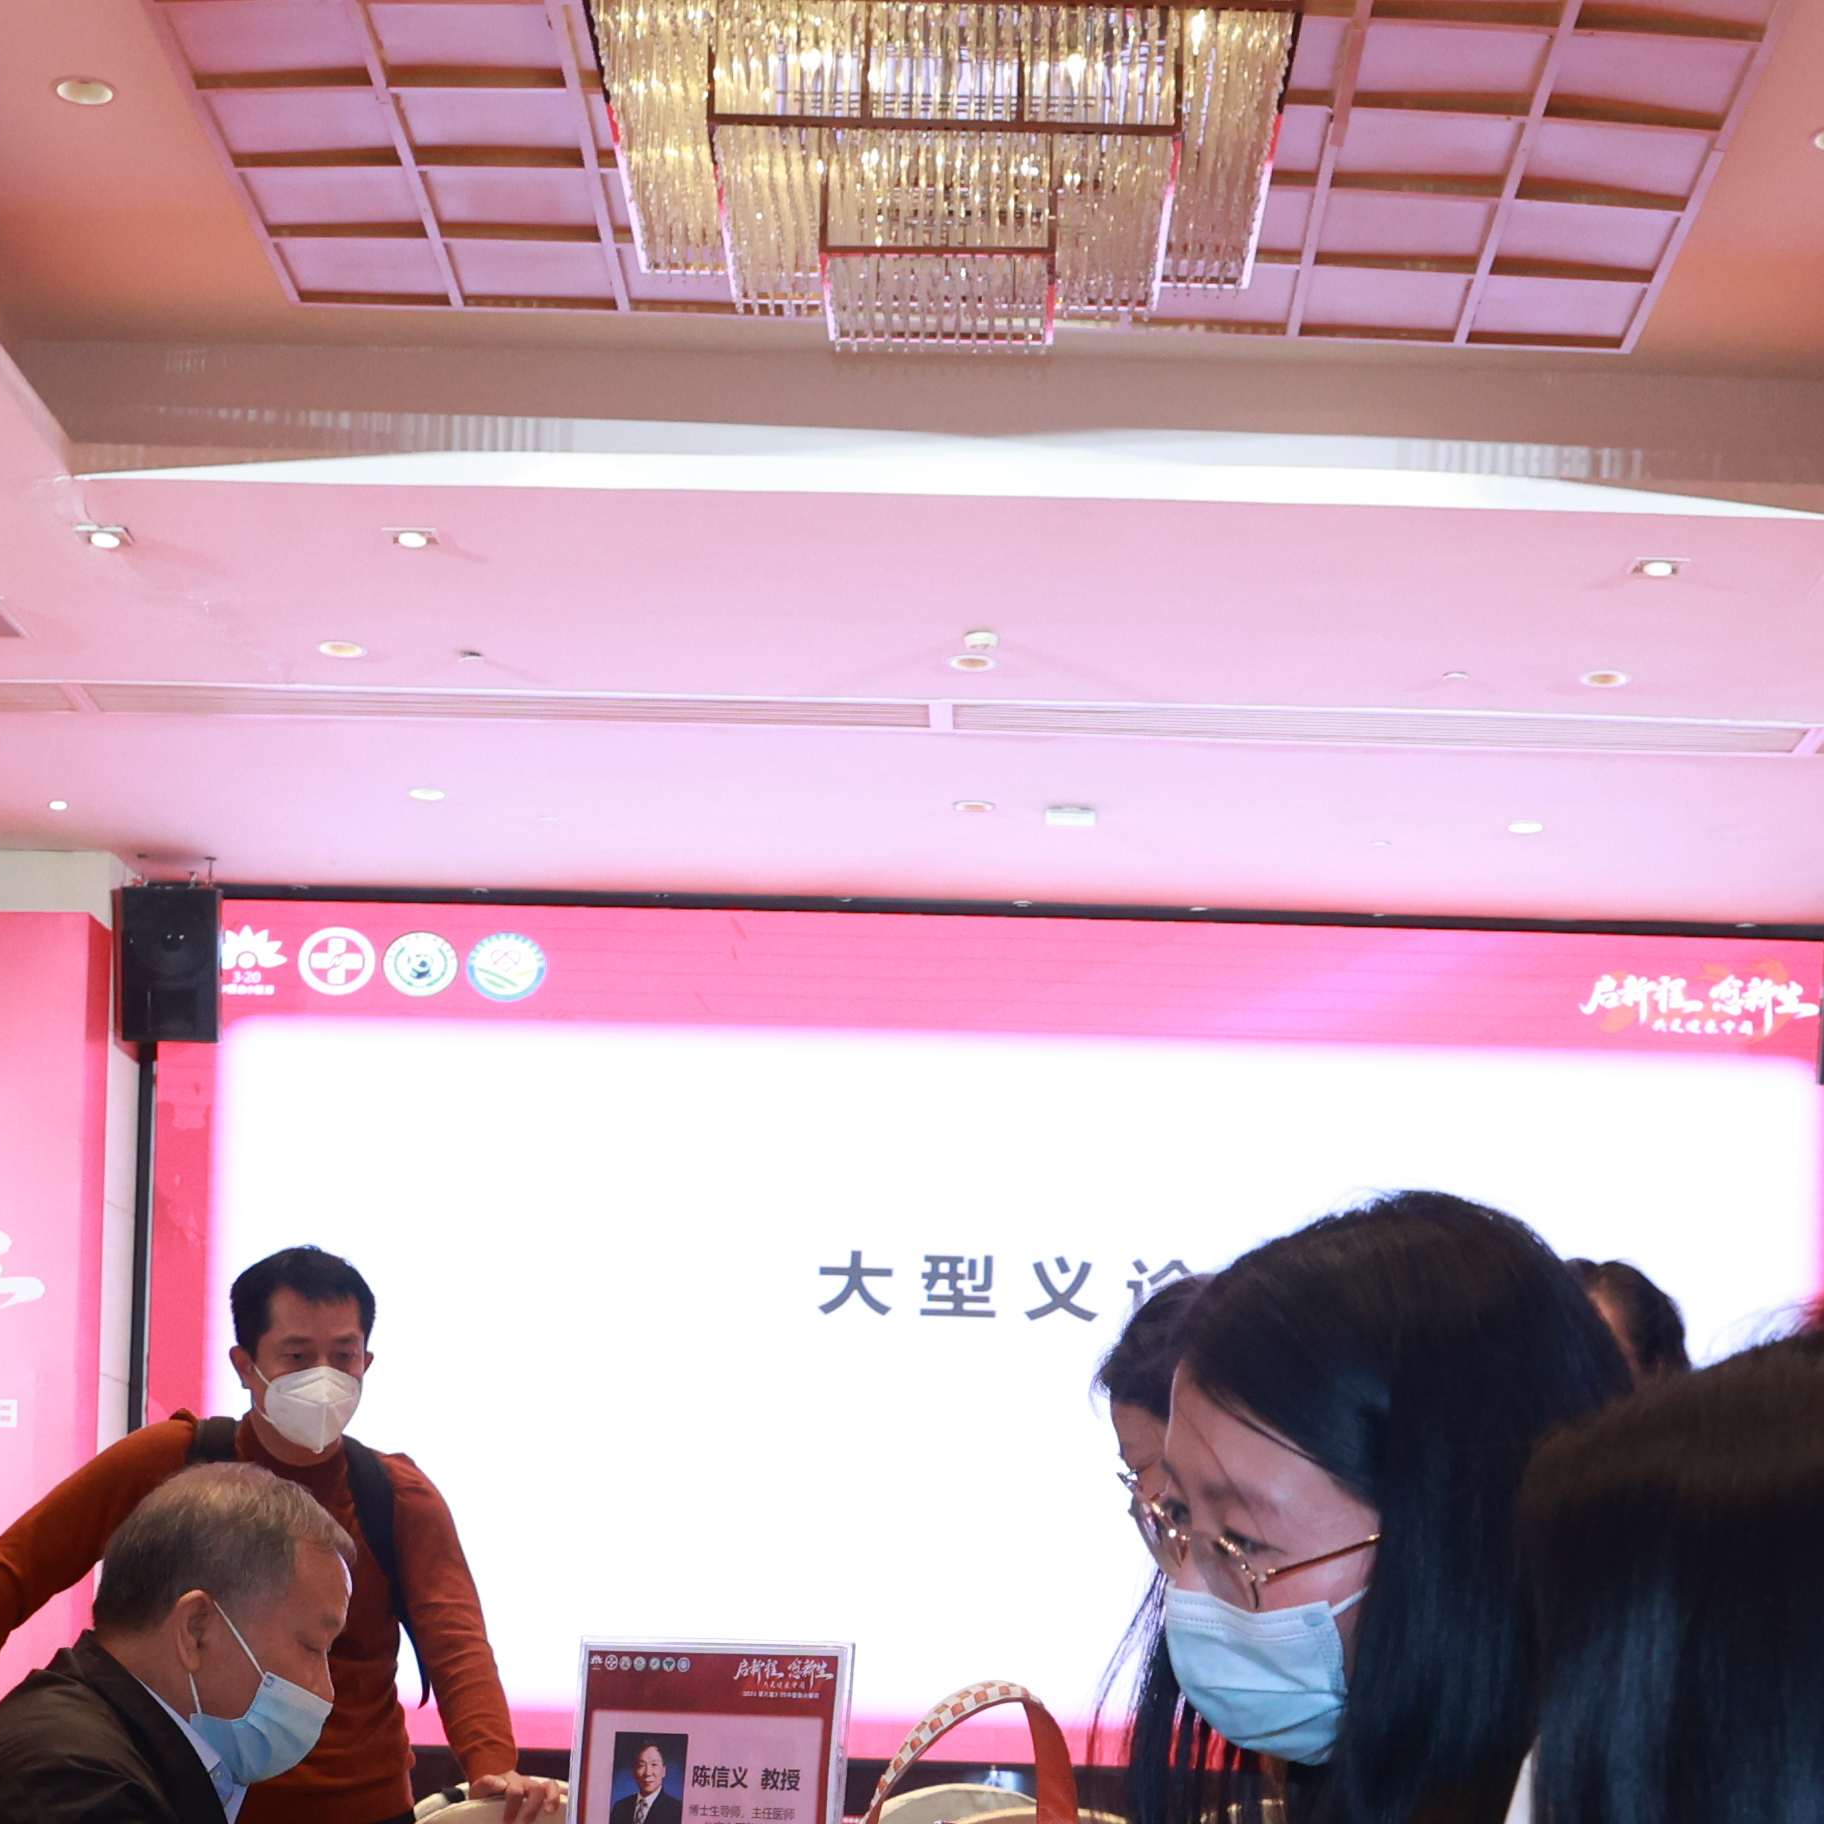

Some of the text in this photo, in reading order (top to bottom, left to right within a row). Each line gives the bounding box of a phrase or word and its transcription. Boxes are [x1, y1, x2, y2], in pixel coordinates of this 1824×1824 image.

[691, 1765, 801, 1791] 陈信义 教授
